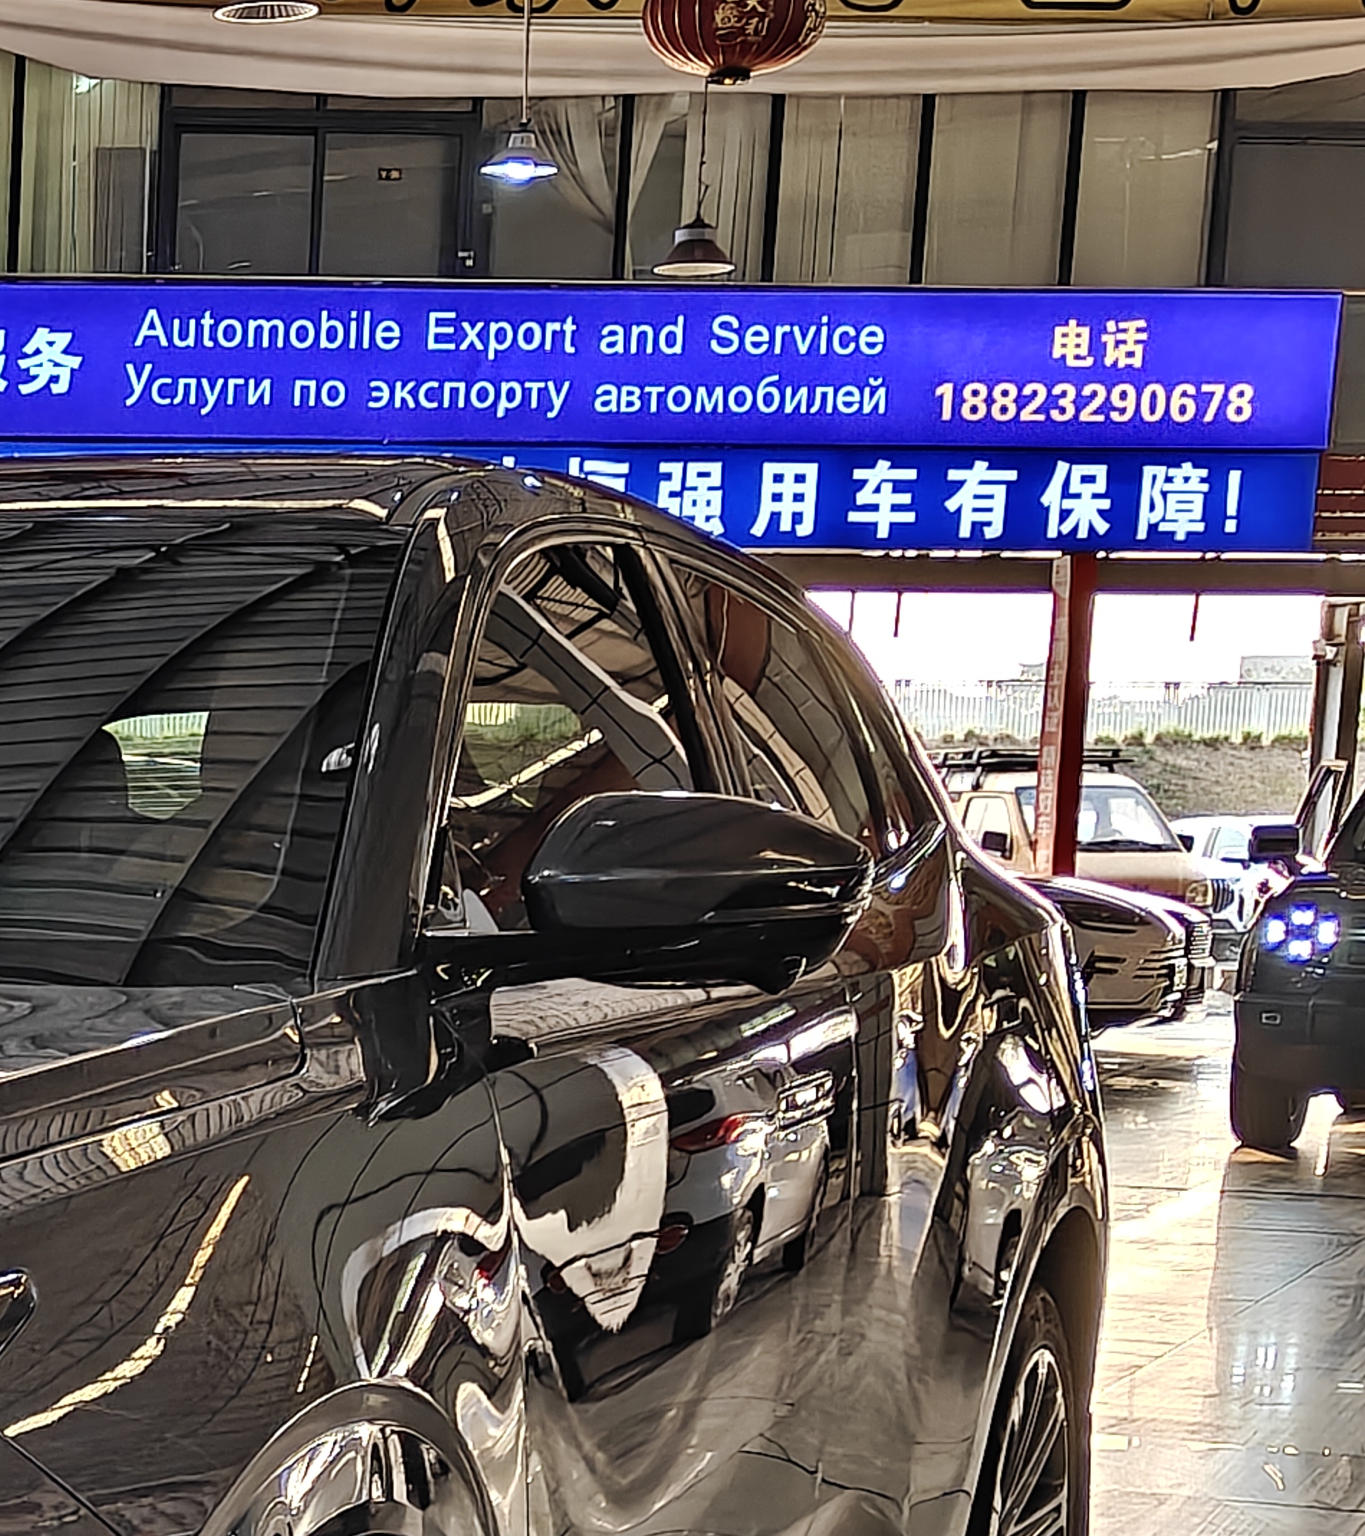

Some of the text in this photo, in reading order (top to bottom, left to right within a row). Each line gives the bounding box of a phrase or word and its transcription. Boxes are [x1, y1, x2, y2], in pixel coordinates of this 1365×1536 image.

[135, 309, 885, 358] Automobile Export and Service
[1051, 319, 1149, 369] 电话
[125, 364, 887, 419] Услуги по экспорту автомобилей
[934, 382, 1255, 423] 18823290678
